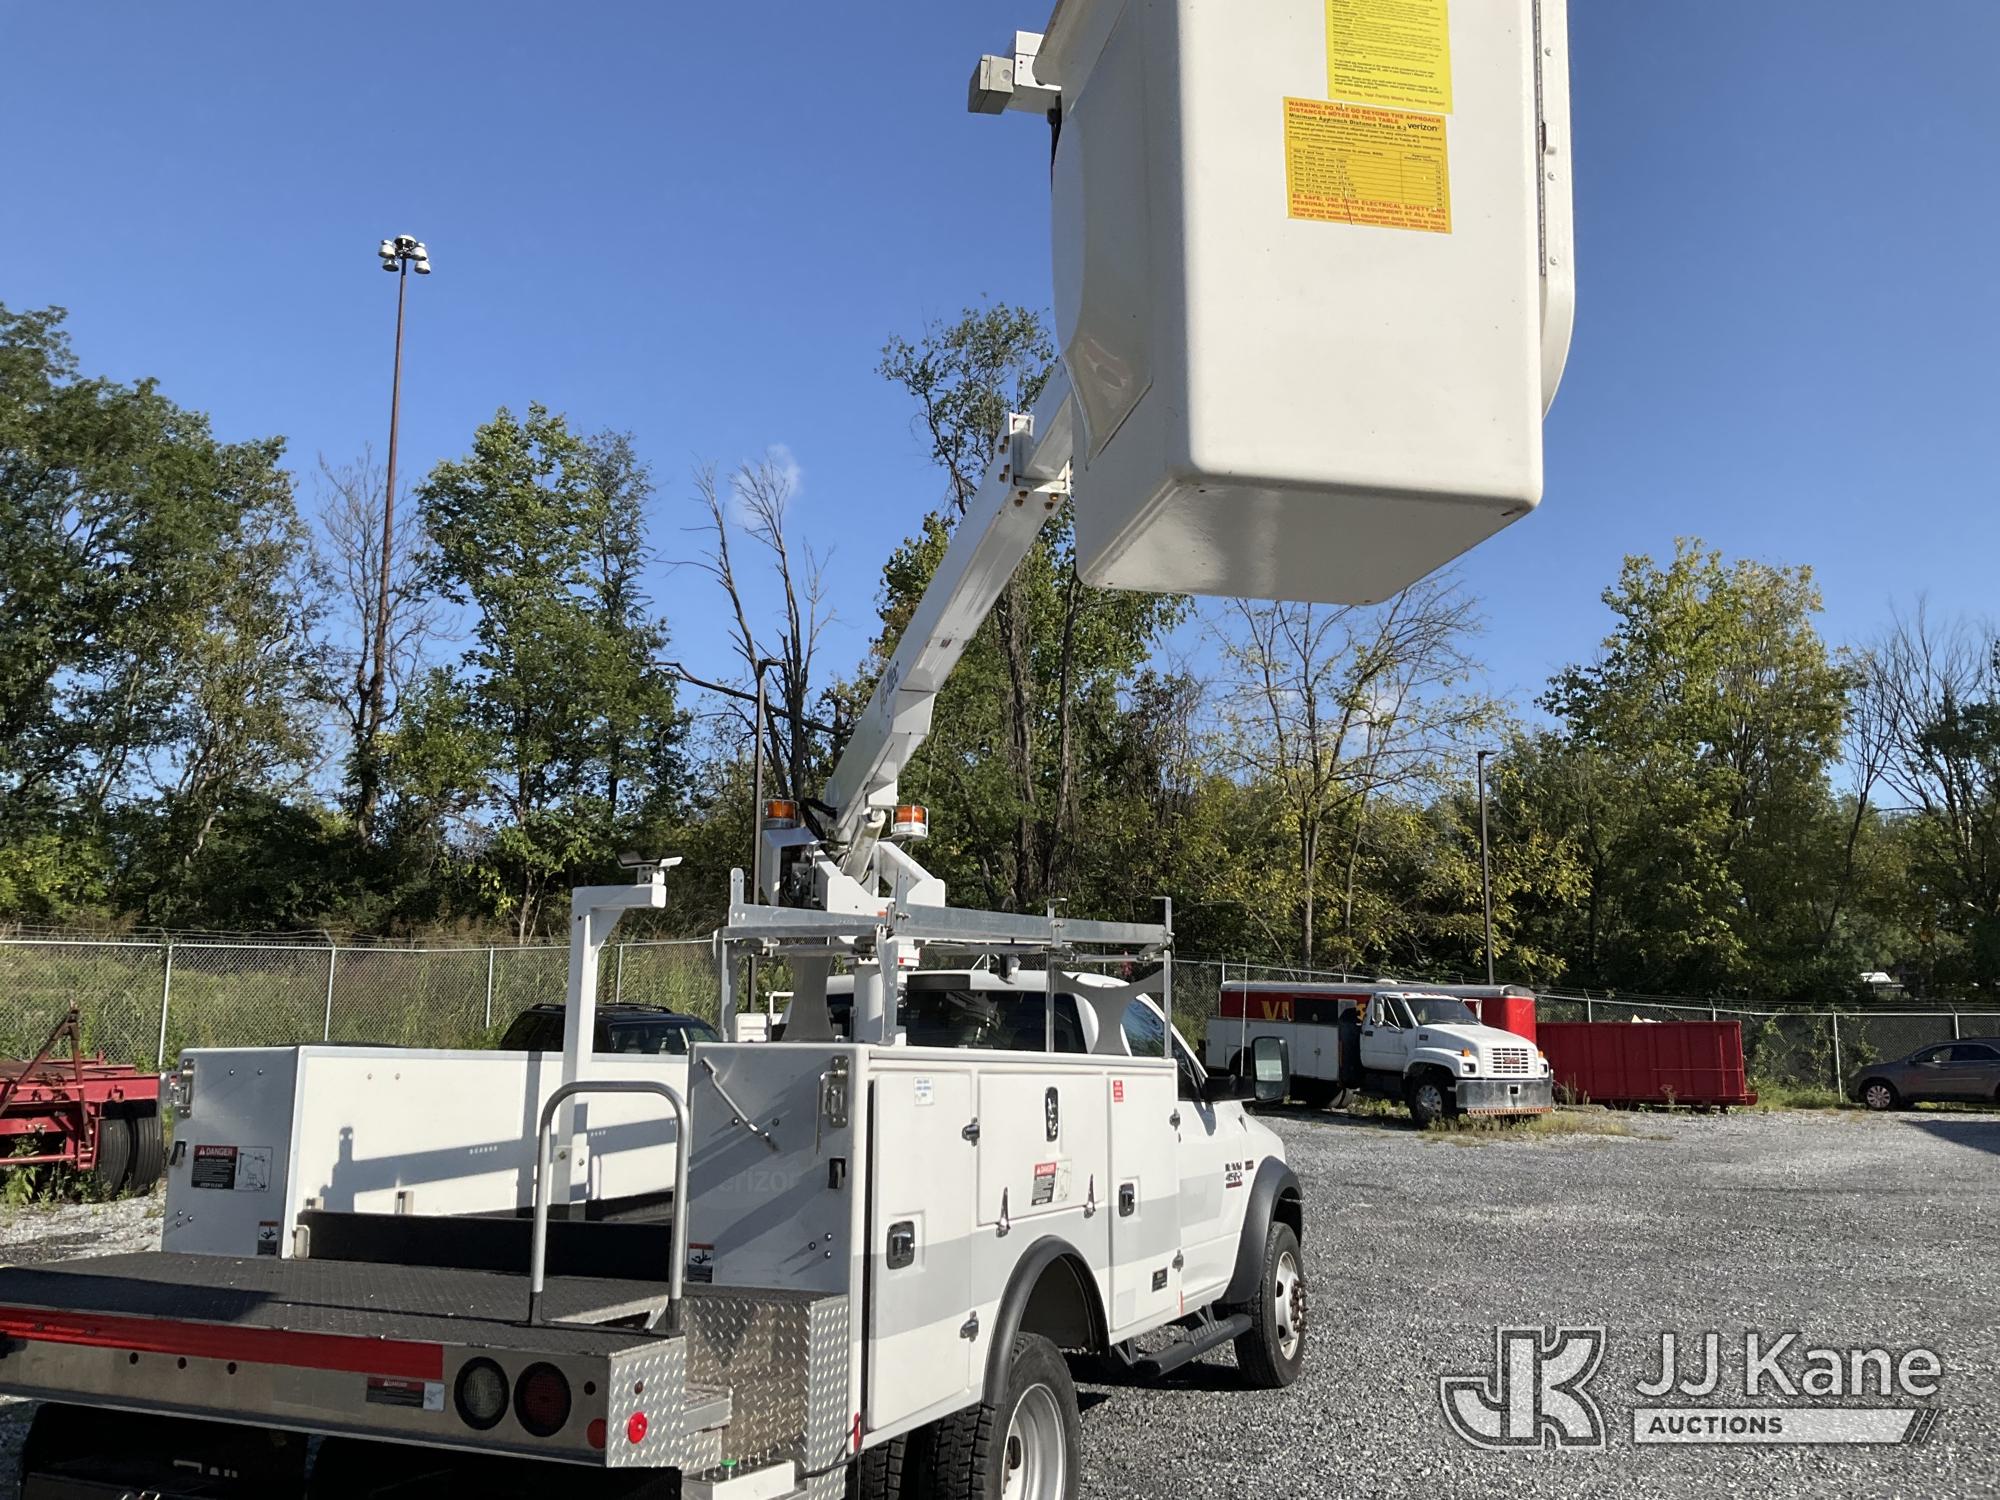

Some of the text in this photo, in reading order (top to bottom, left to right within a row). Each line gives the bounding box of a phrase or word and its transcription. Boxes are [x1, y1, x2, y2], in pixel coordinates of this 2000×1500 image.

[1289, 106, 1326, 116] DISTANCES
[1362, 109, 1389, 117] BEYOND
[1406, 115, 1441, 123] APPROACH
[1289, 113, 1317, 121] Minimum
[1319, 116, 1348, 125] Approach
[1350, 120, 1376, 128] Distance
[1407, 122, 1437, 131] verizon
[1293, 200, 1325, 208] PERSONAL
[1367, 207, 1403, 216] EQUIPMENT
[1361, 200, 1401, 209] ELECTRICAL
[206, 1147, 233, 1156] DANGER
